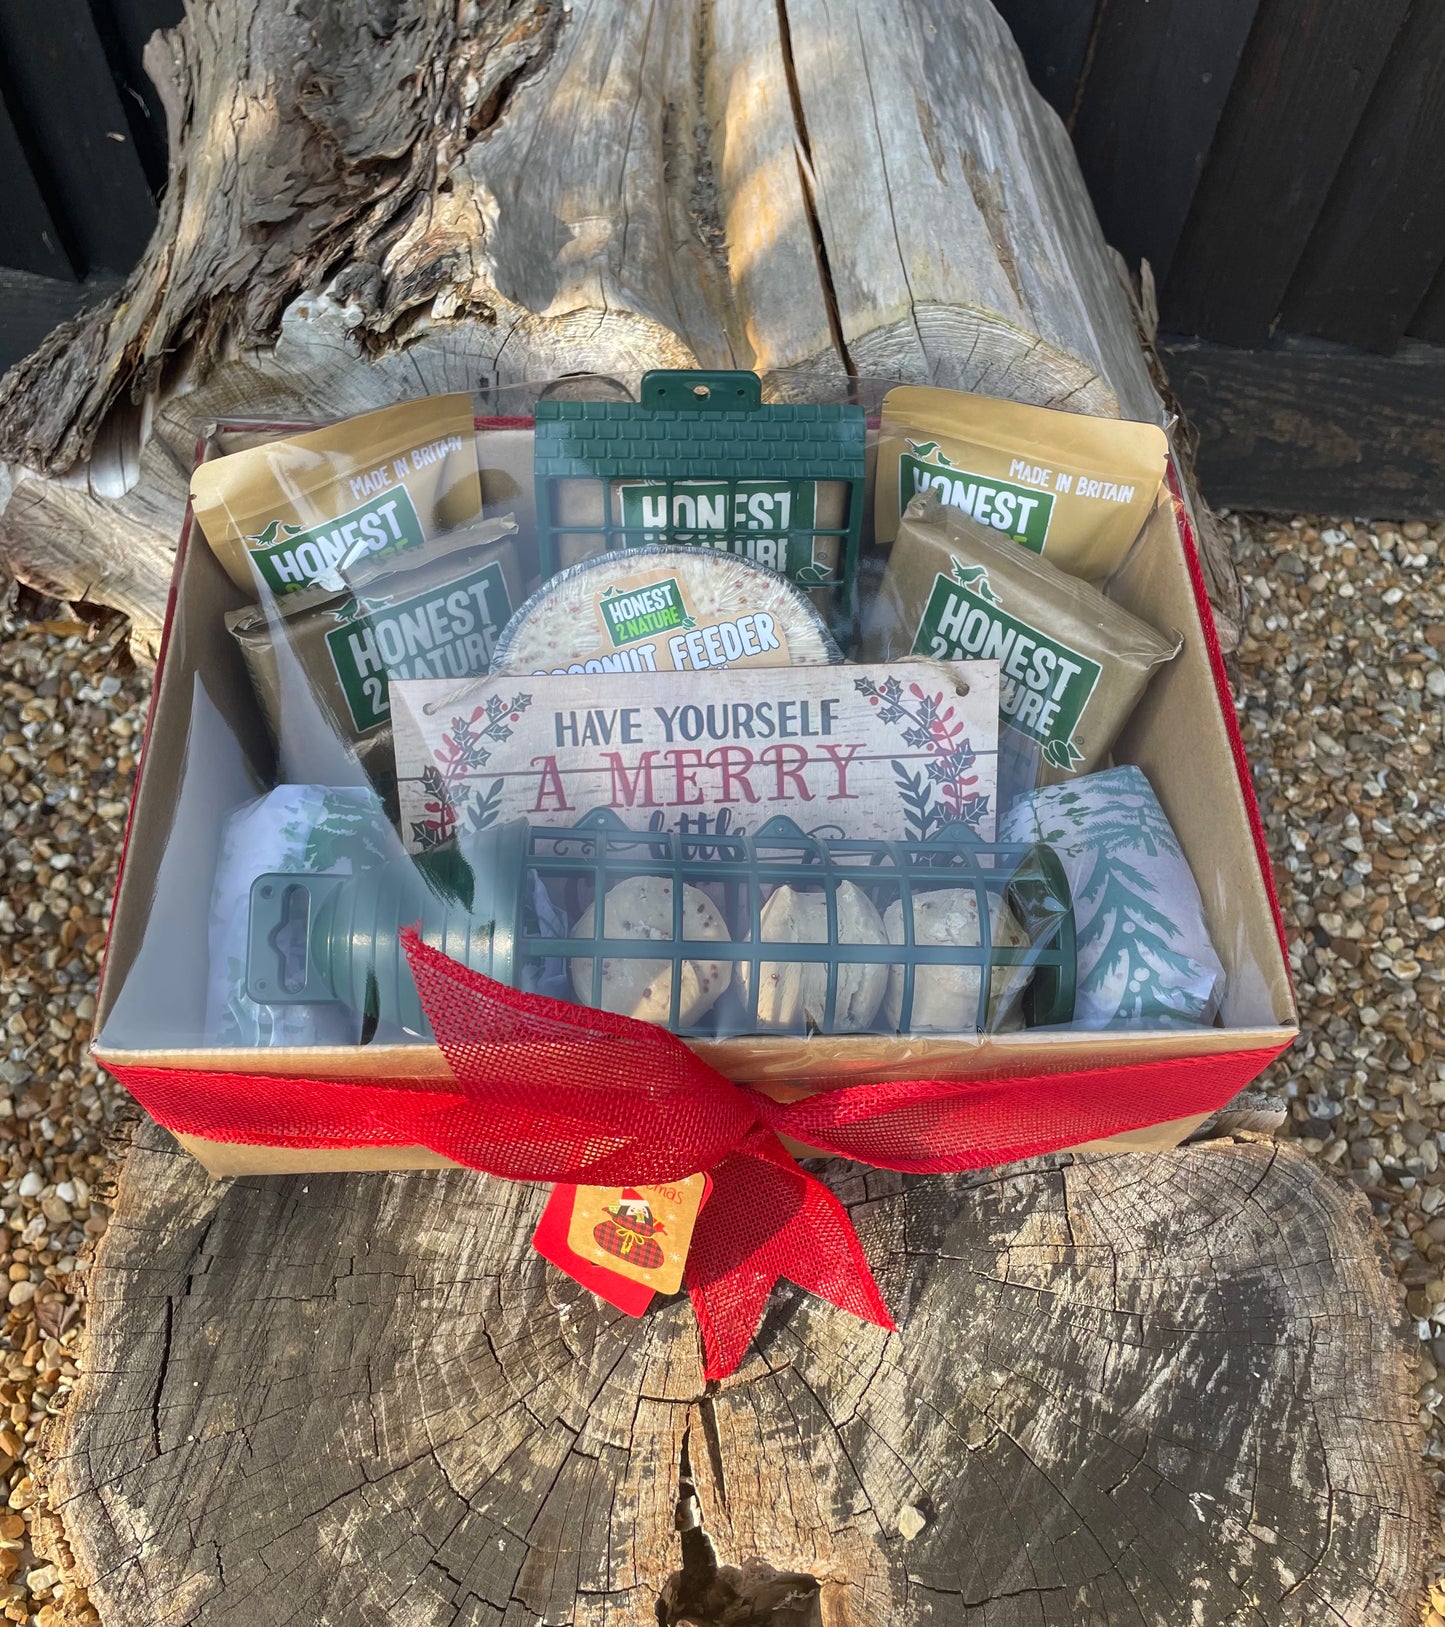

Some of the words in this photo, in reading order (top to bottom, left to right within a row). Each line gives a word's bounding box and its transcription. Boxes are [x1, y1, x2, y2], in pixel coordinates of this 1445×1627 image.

[349, 465, 392, 500] MADE
[393, 457, 410, 479] IN
[411, 435, 463, 470] BRITAIN
[1009, 459, 1052, 488] MADE
[1055, 472, 1073, 493] IN
[1075, 476, 1135, 503] BRITAIN
[642, 492, 792, 542] HONEST
[913, 467, 1039, 534] HONEST
[270, 500, 403, 583] HONEST
[348, 579, 490, 678] HONEST
[608, 585, 674, 624] HONEST
[616, 623, 629, 641] 2
[626, 606, 681, 638] NATURE
[669, 611, 781, 671] FEEDER
[937, 594, 1082, 702] HONEST
[363, 677, 390, 715] 2
[554, 707, 643, 748] HAVE
[653, 698, 841, 743] YOURSELF
[527, 755, 576, 813] A
[600, 743, 867, 810] MERRY
